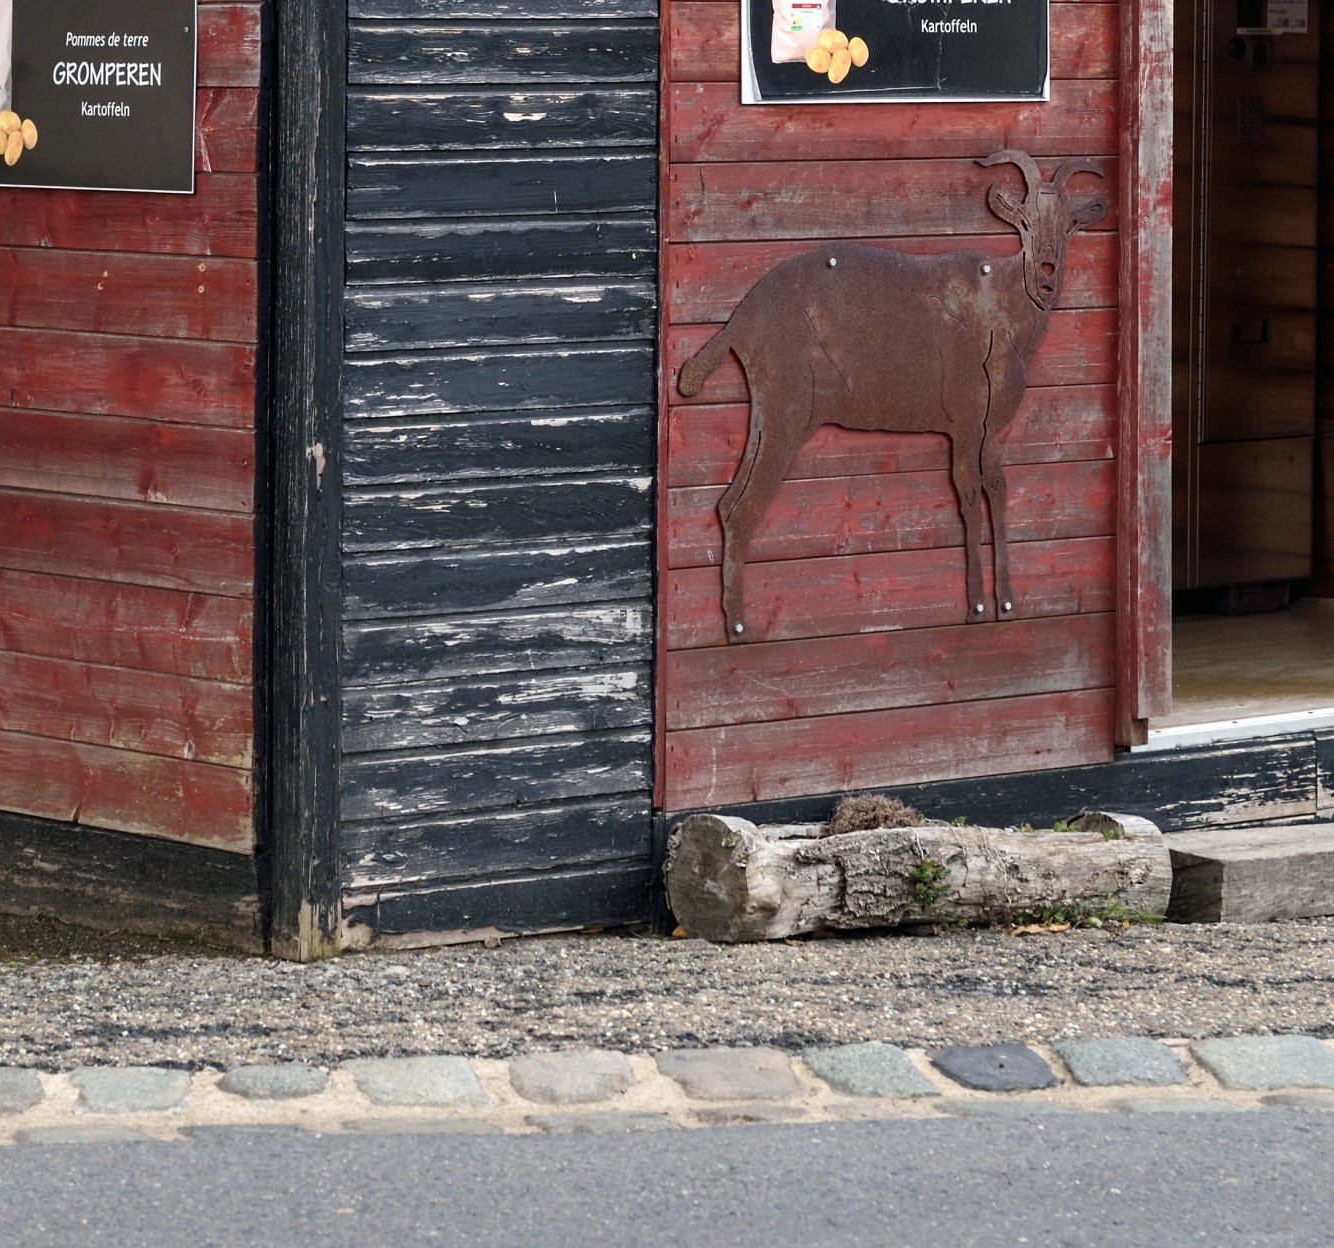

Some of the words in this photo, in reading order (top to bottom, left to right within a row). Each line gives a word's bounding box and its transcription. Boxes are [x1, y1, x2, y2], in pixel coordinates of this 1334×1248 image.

[921, 18, 978, 34] Kartoffeln
[65, 31, 106, 48] Pommes
[107, 31, 121, 47] de
[123, 32, 149, 48] terre
[52, 60, 162, 87] GROMPEREN
[81, 101, 131, 118] Kartoffeln
